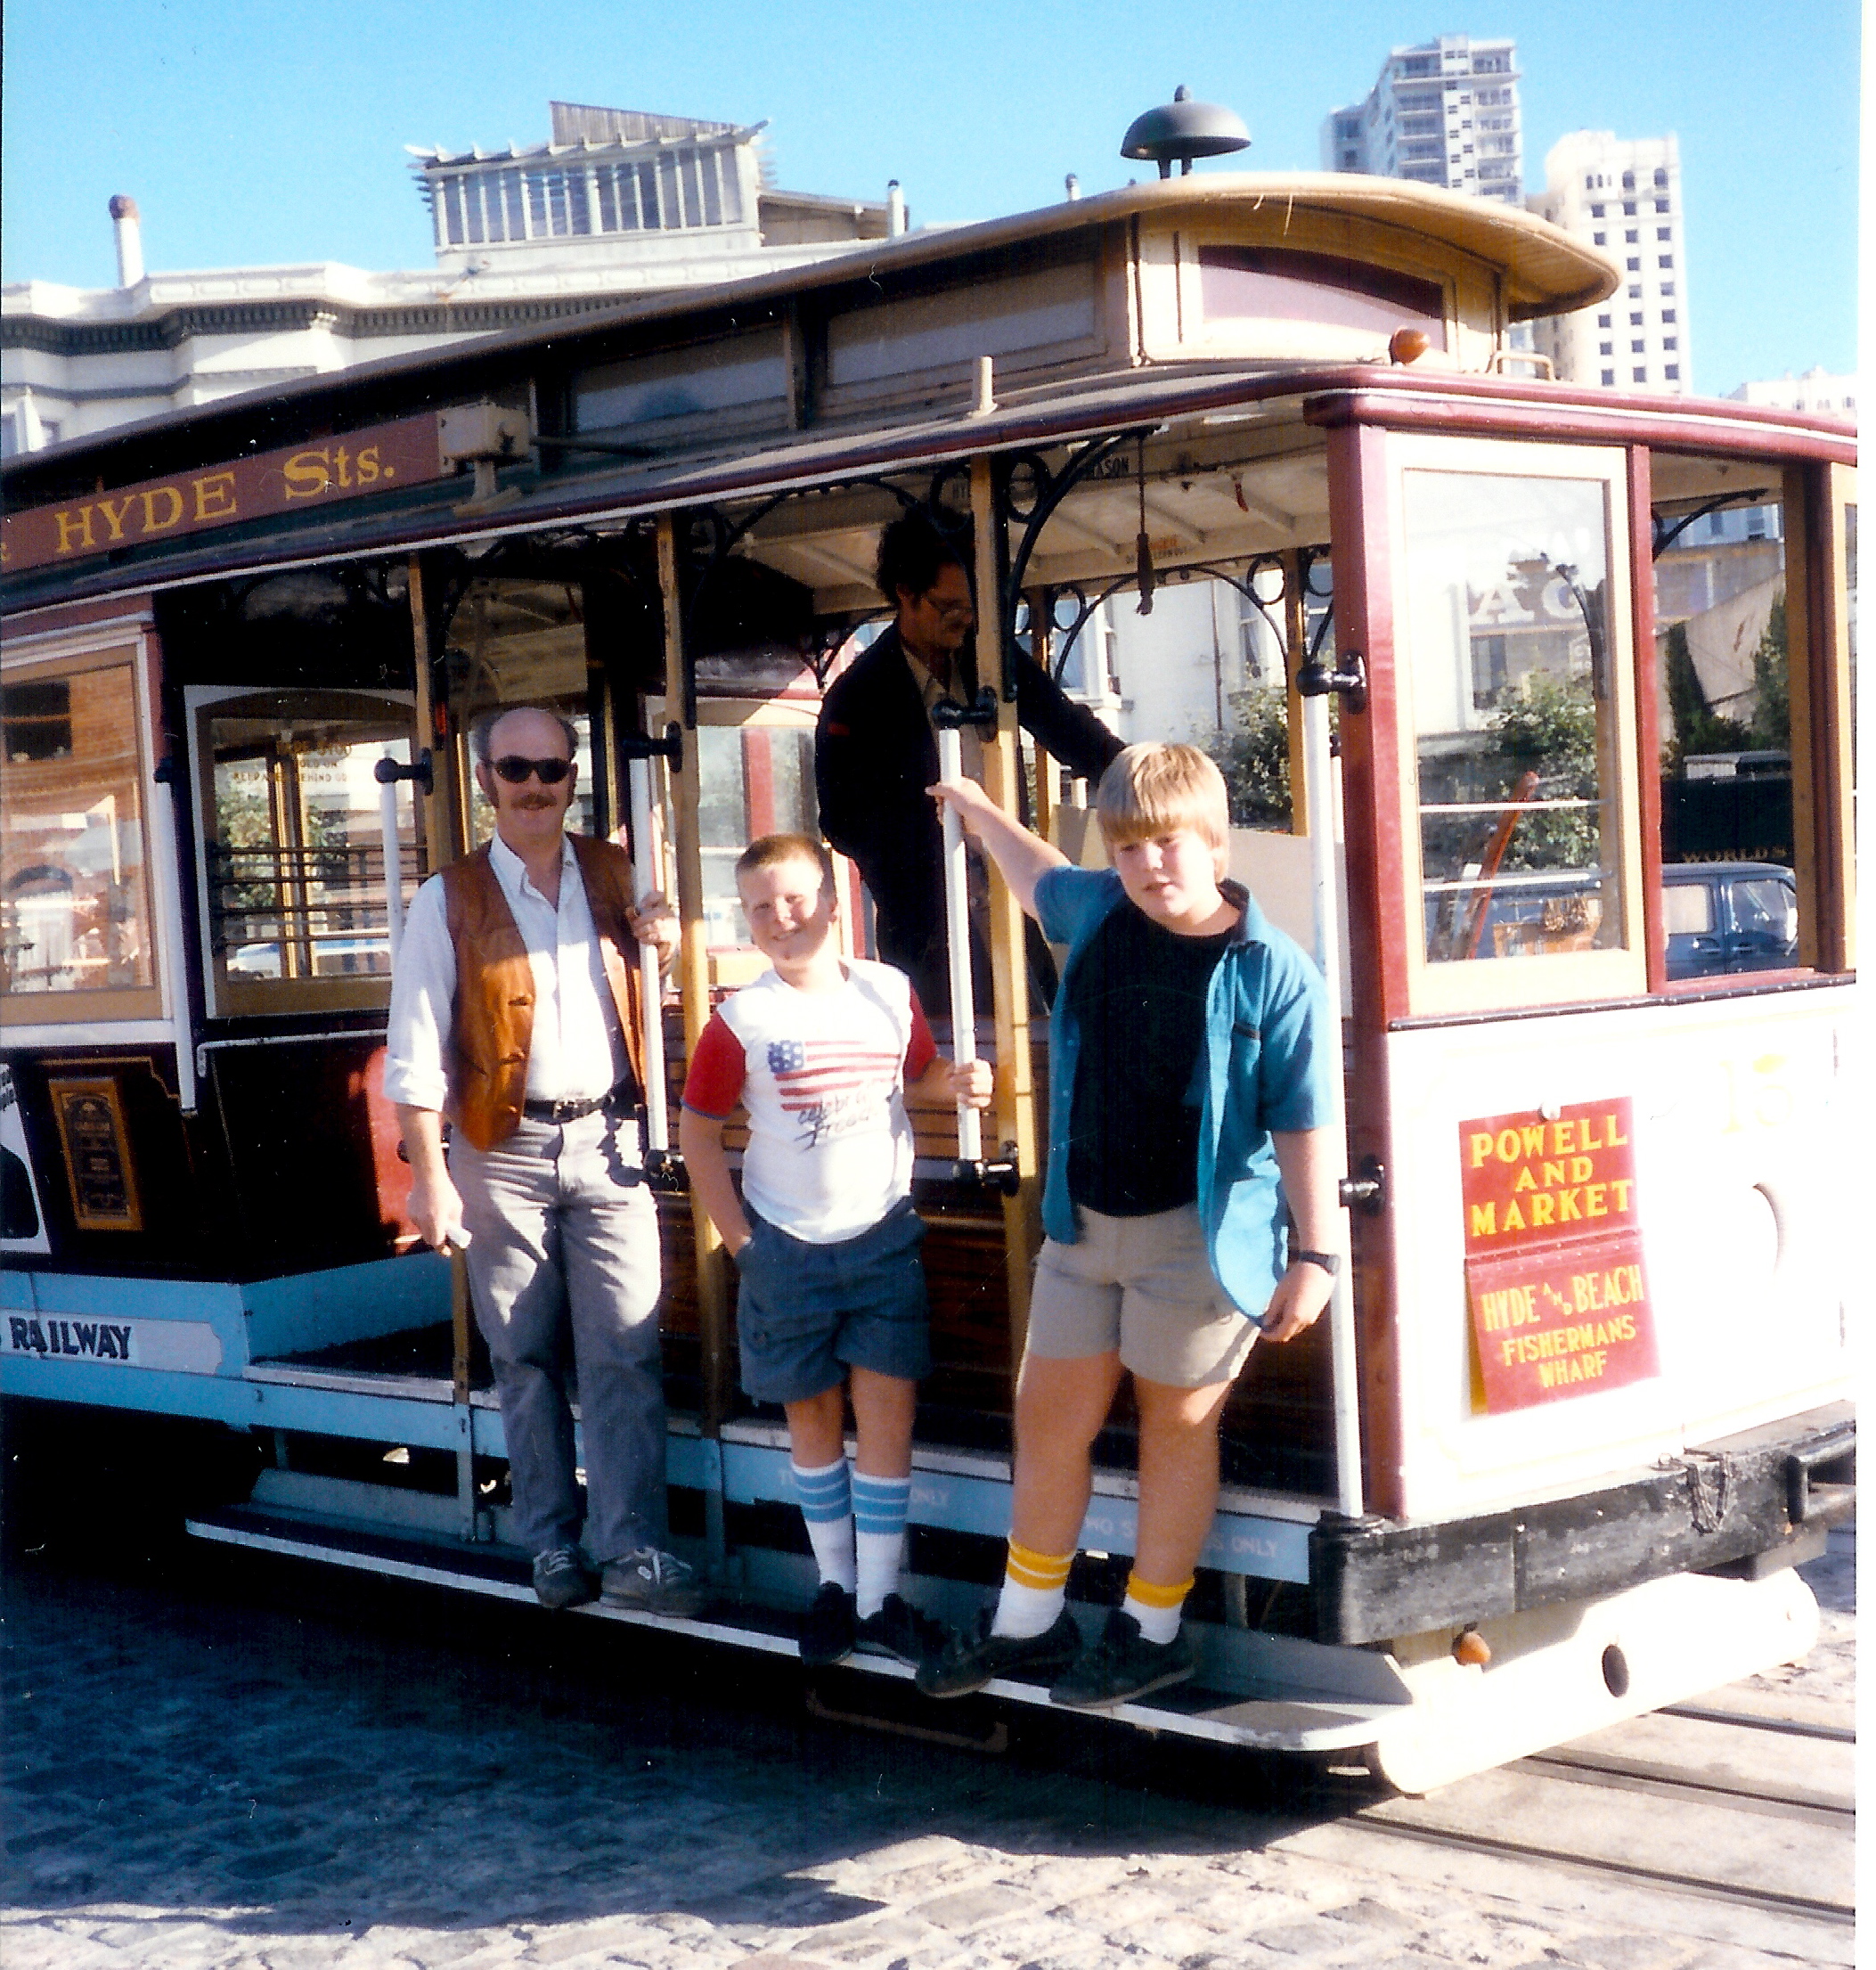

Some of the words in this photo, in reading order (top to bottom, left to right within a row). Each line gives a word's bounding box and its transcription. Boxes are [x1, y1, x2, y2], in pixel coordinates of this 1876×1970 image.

[54, 471, 238, 553] HYDE
[283, 444, 396, 502] Sts.
[1717, 1052, 1795, 1137] 15
[1471, 1114, 1628, 1168] POWELL
[1514, 1156, 1594, 1193] AND
[1471, 1179, 1633, 1237] MARKET
[1480, 1284, 1541, 1333] HYDE
[1542, 1283, 1573, 1316] AND
[1572, 1263, 1645, 1313] BEACH
[8, 1315, 132, 1361] RAILWAY
[1501, 1314, 1637, 1367] FISHERMANS
[1538, 1350, 1609, 1389] WHARF
[1231, 1535, 1278, 1558] ONLY
